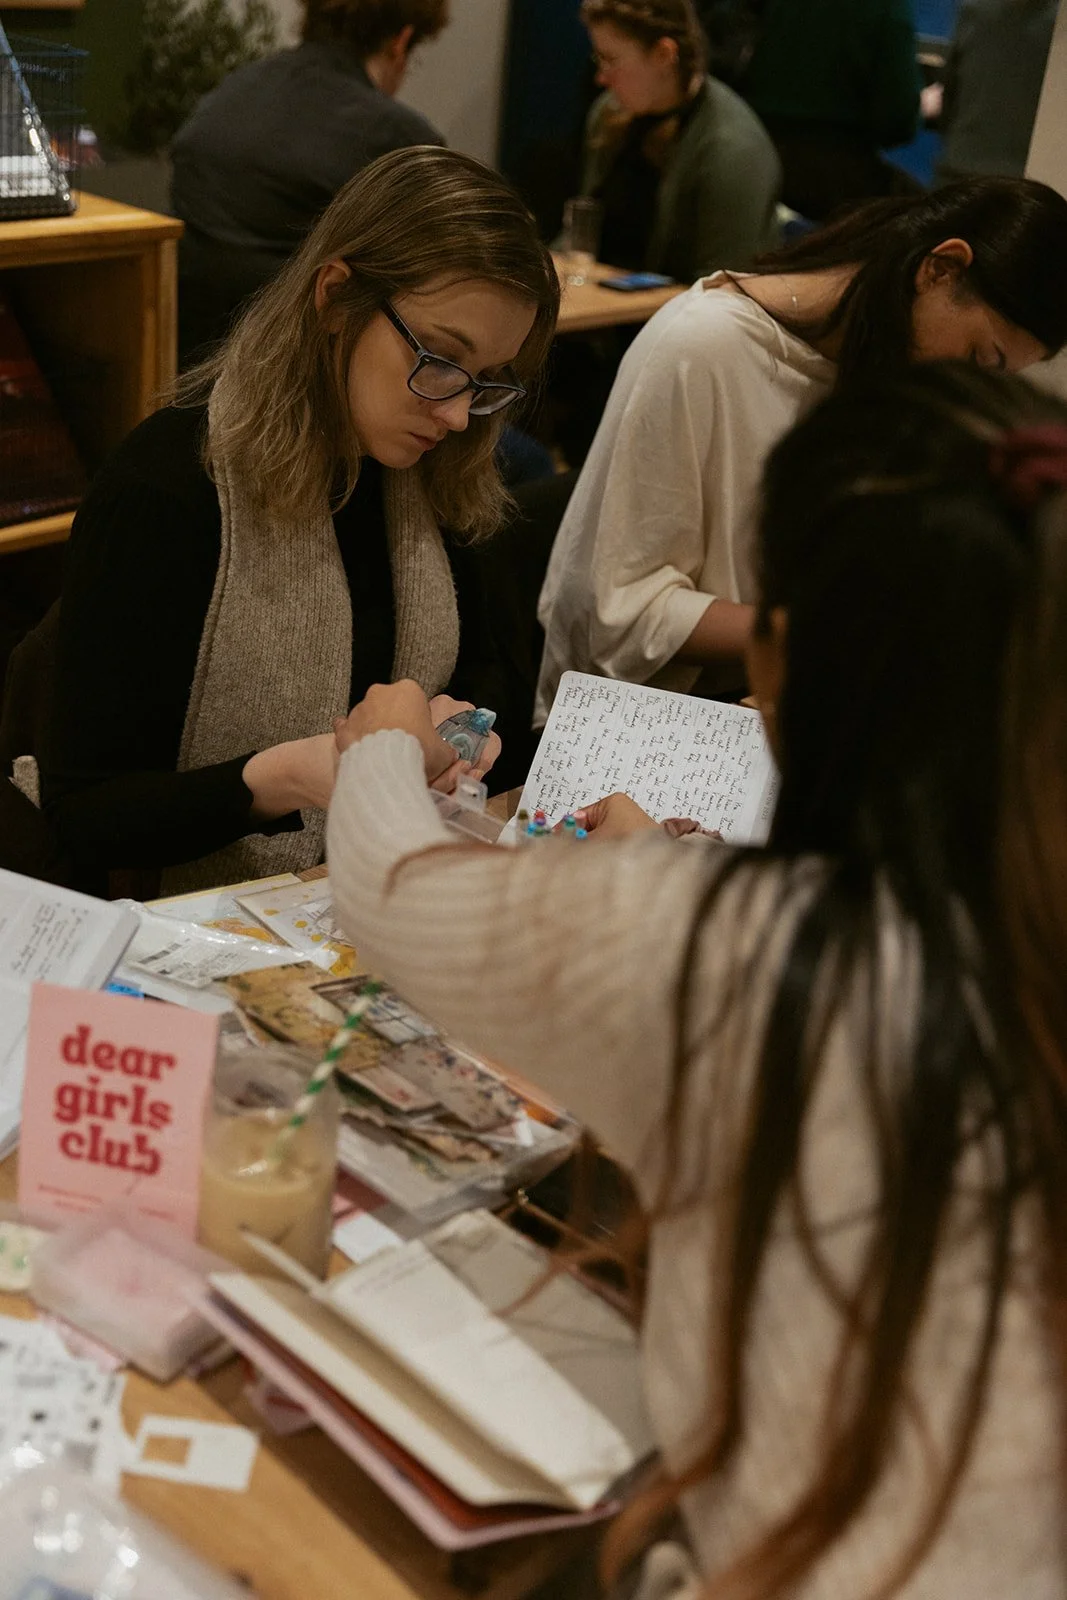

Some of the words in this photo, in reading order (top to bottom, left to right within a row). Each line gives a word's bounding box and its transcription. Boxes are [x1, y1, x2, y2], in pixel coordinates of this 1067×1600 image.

[60, 1023, 177, 1082] dear
[54, 1075, 173, 1131] girls
[58, 1123, 163, 1177] club
